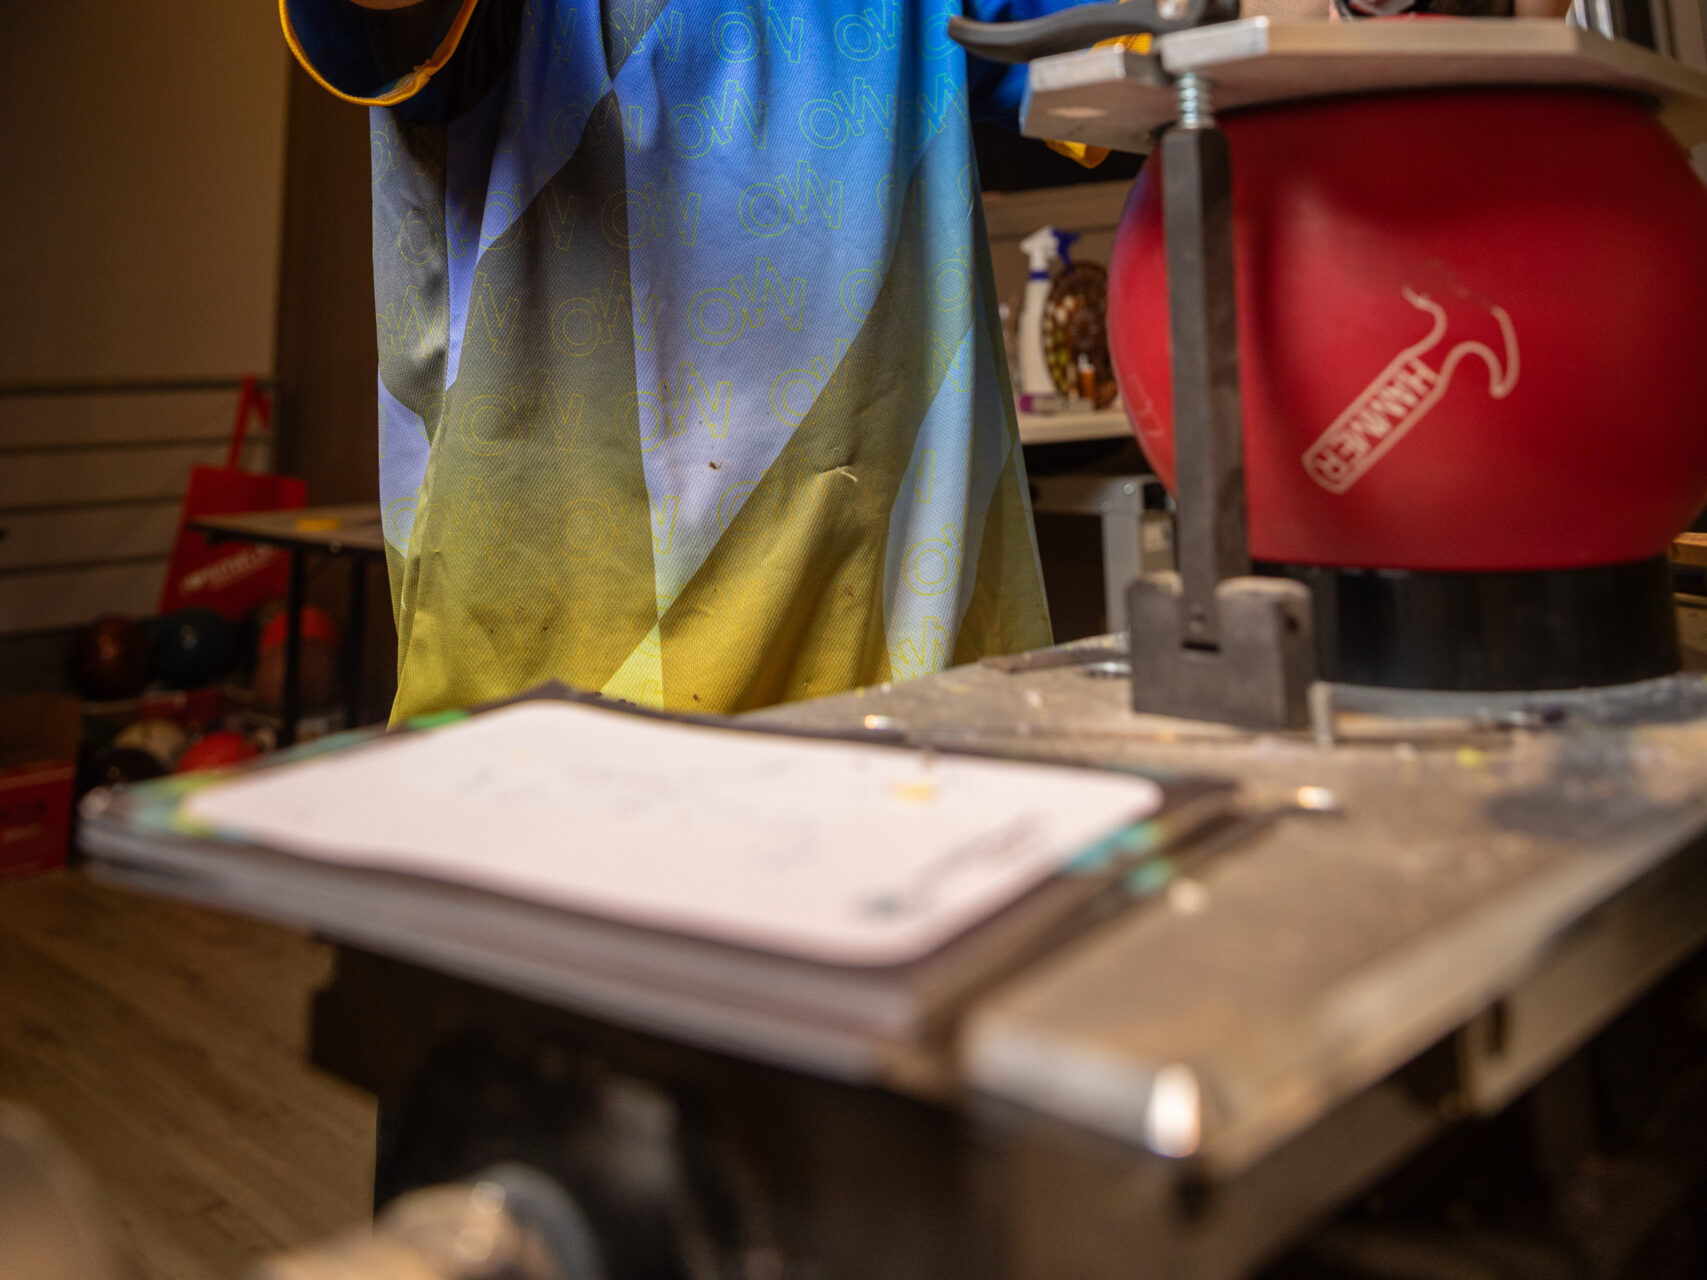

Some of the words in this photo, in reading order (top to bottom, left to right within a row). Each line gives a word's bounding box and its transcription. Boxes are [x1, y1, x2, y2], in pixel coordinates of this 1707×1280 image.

[668, 80, 768, 160] OW
[738, 160, 844, 238] OW
[688, 257, 806, 347] OW
